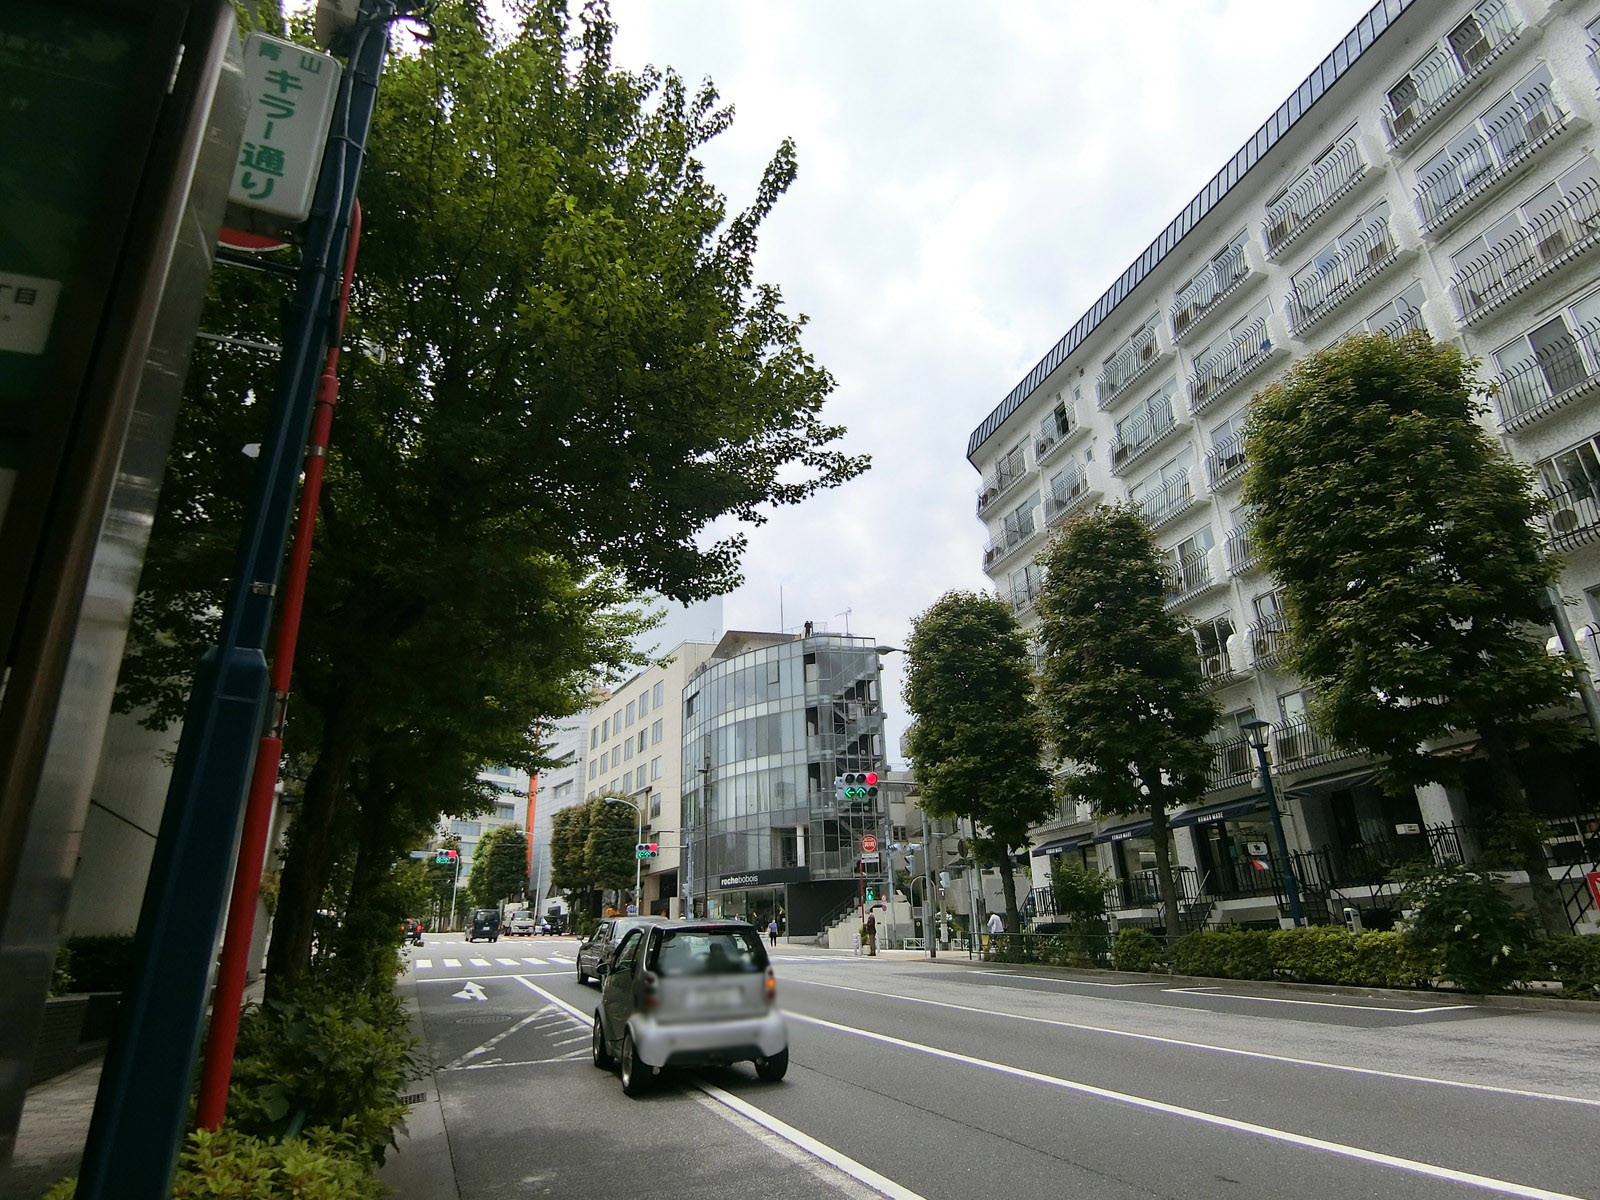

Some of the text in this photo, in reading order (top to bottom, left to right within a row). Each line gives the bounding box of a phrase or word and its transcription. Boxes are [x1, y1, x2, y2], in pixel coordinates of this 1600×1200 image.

[259, 41, 321, 74] 青山
[239, 69, 303, 199] キラー通り
